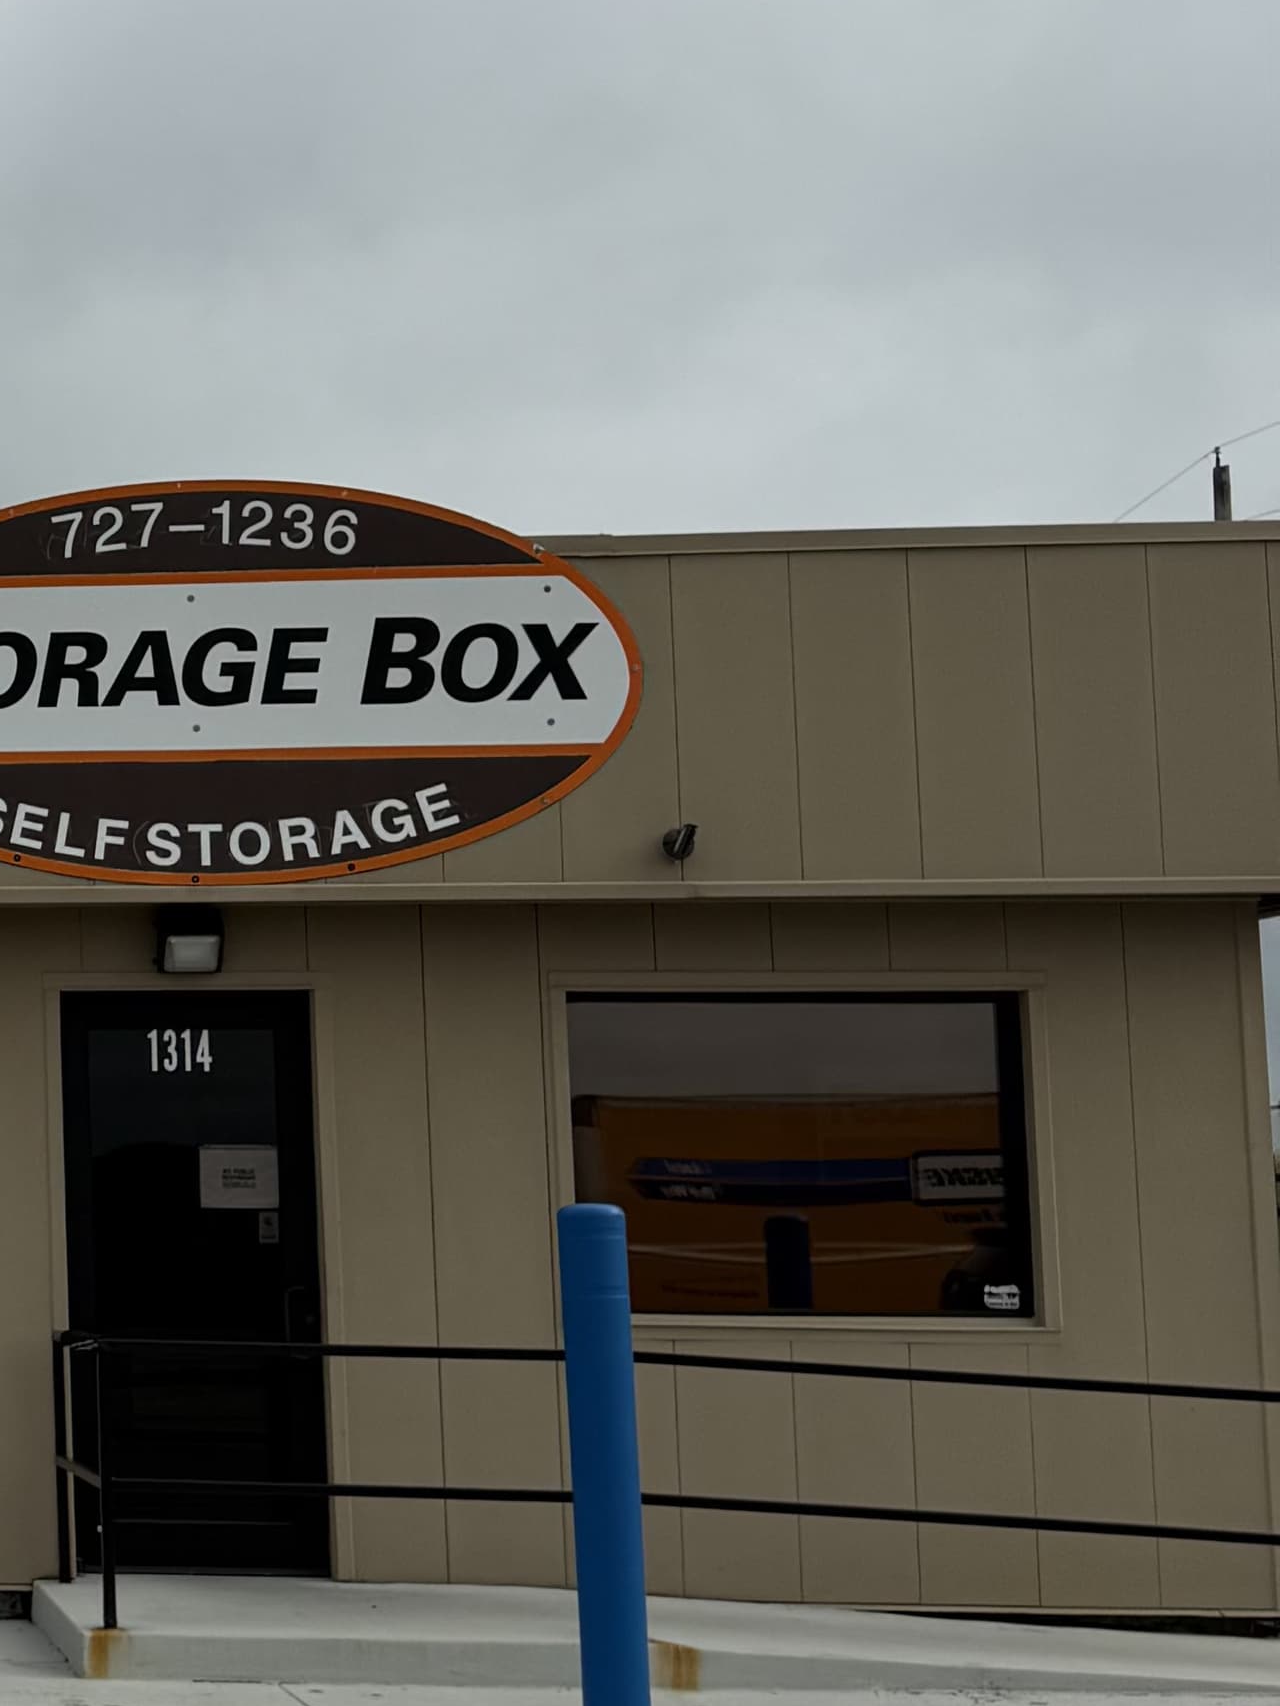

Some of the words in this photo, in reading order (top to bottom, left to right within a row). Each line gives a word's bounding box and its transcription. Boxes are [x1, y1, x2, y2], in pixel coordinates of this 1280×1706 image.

[50, 499, 359, 559] 727-1236
[360, 616, 600, 706] BOX
[144, 782, 462, 867] STORAGE
[147, 1028, 212, 1072] 1314
